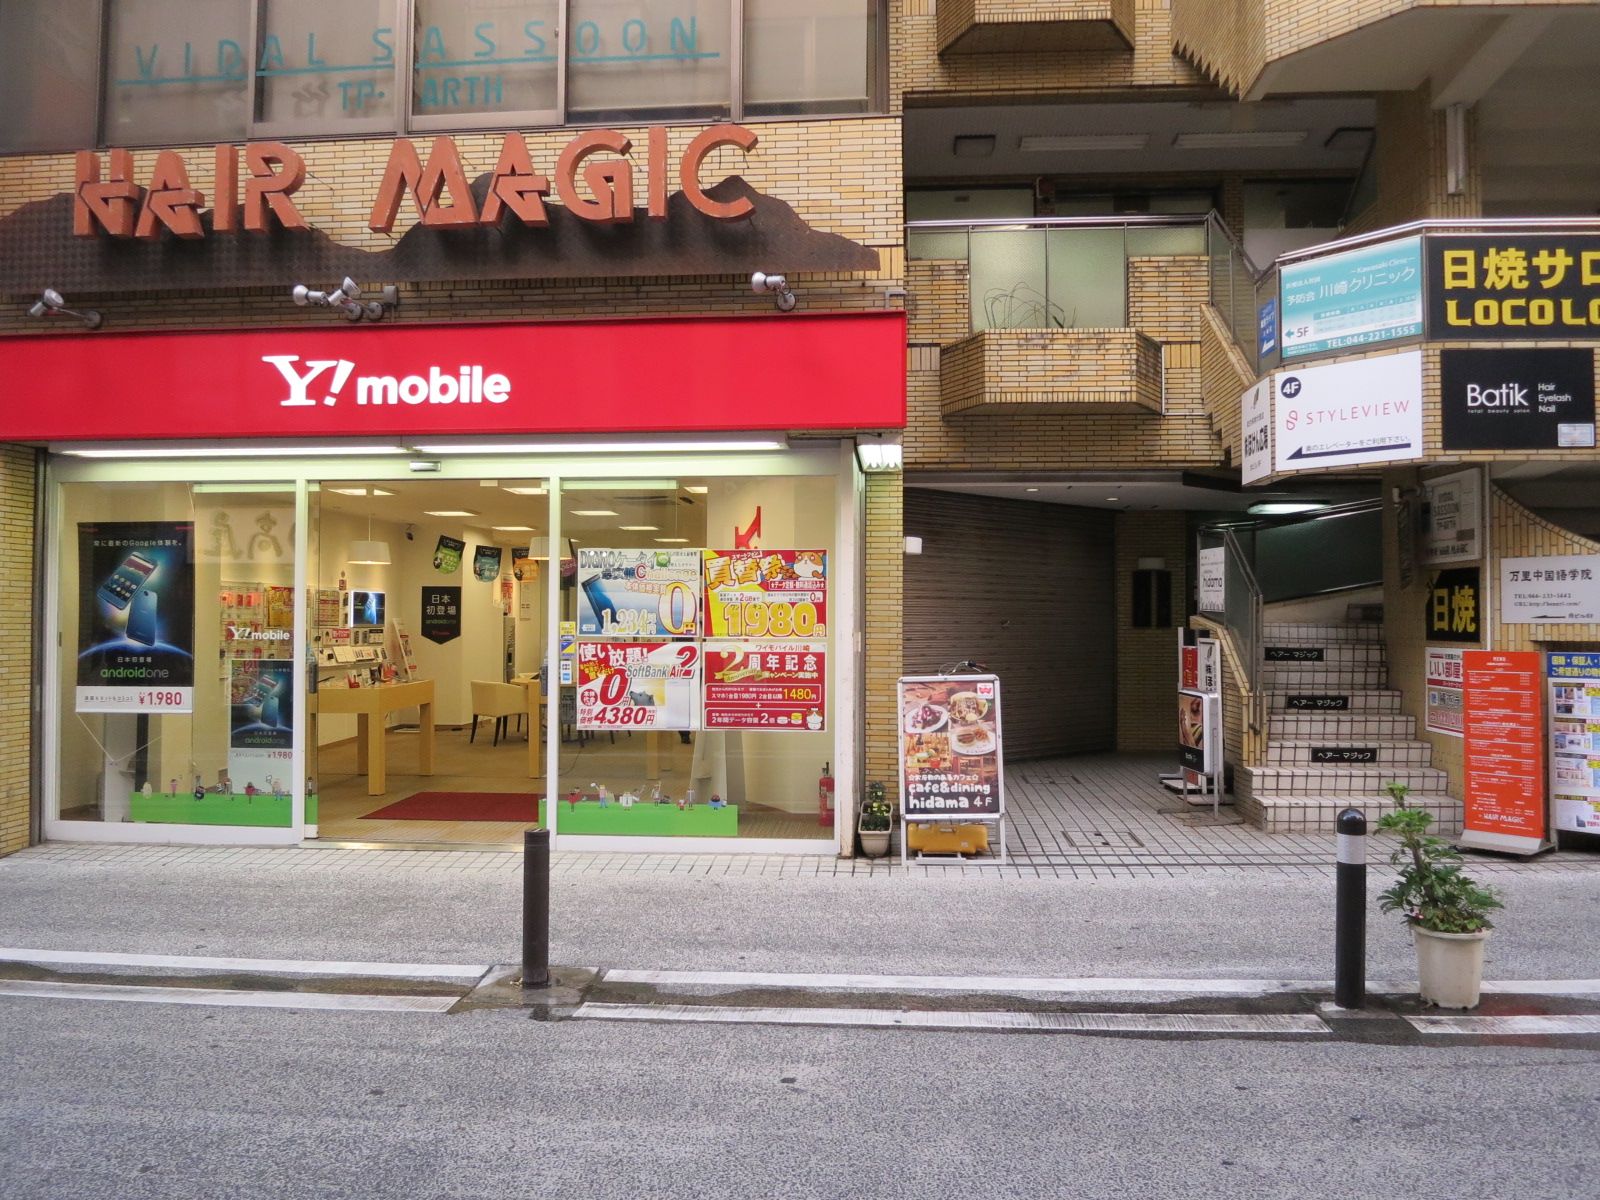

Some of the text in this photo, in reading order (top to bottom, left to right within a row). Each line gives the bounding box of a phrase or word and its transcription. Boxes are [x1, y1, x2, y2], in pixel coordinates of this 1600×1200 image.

[135, 16, 698, 78] VIDAL SASSOON
[73, 125, 759, 239] HAIR MAGIC
[1319, 266, 1416, 299] 川崎クリニック
[1445, 298, 1554, 327] LOCO
[1296, 326, 1310, 338] 5F
[1282, 381, 1300, 395] 4F
[1537, 383, 1556, 391] Hair
[1466, 383, 1529, 407] Batik
[1537, 393, 1572, 403] Eyelash
[1305, 400, 1410, 425] STYLEVIEW
[1538, 404, 1556, 413] Nail
[1509, 569, 1592, 582] 万里中国語学院
[431, 594, 451, 604] 日本
[426, 605, 456, 615] 初登場
[1433, 585, 1476, 632] 日焼
[626, 664, 667, 679] SoftBank
[1317, 699, 1343, 707] マジック
[1343, 752, 1371, 760] マジック
[909, 796, 970, 809] hidama
